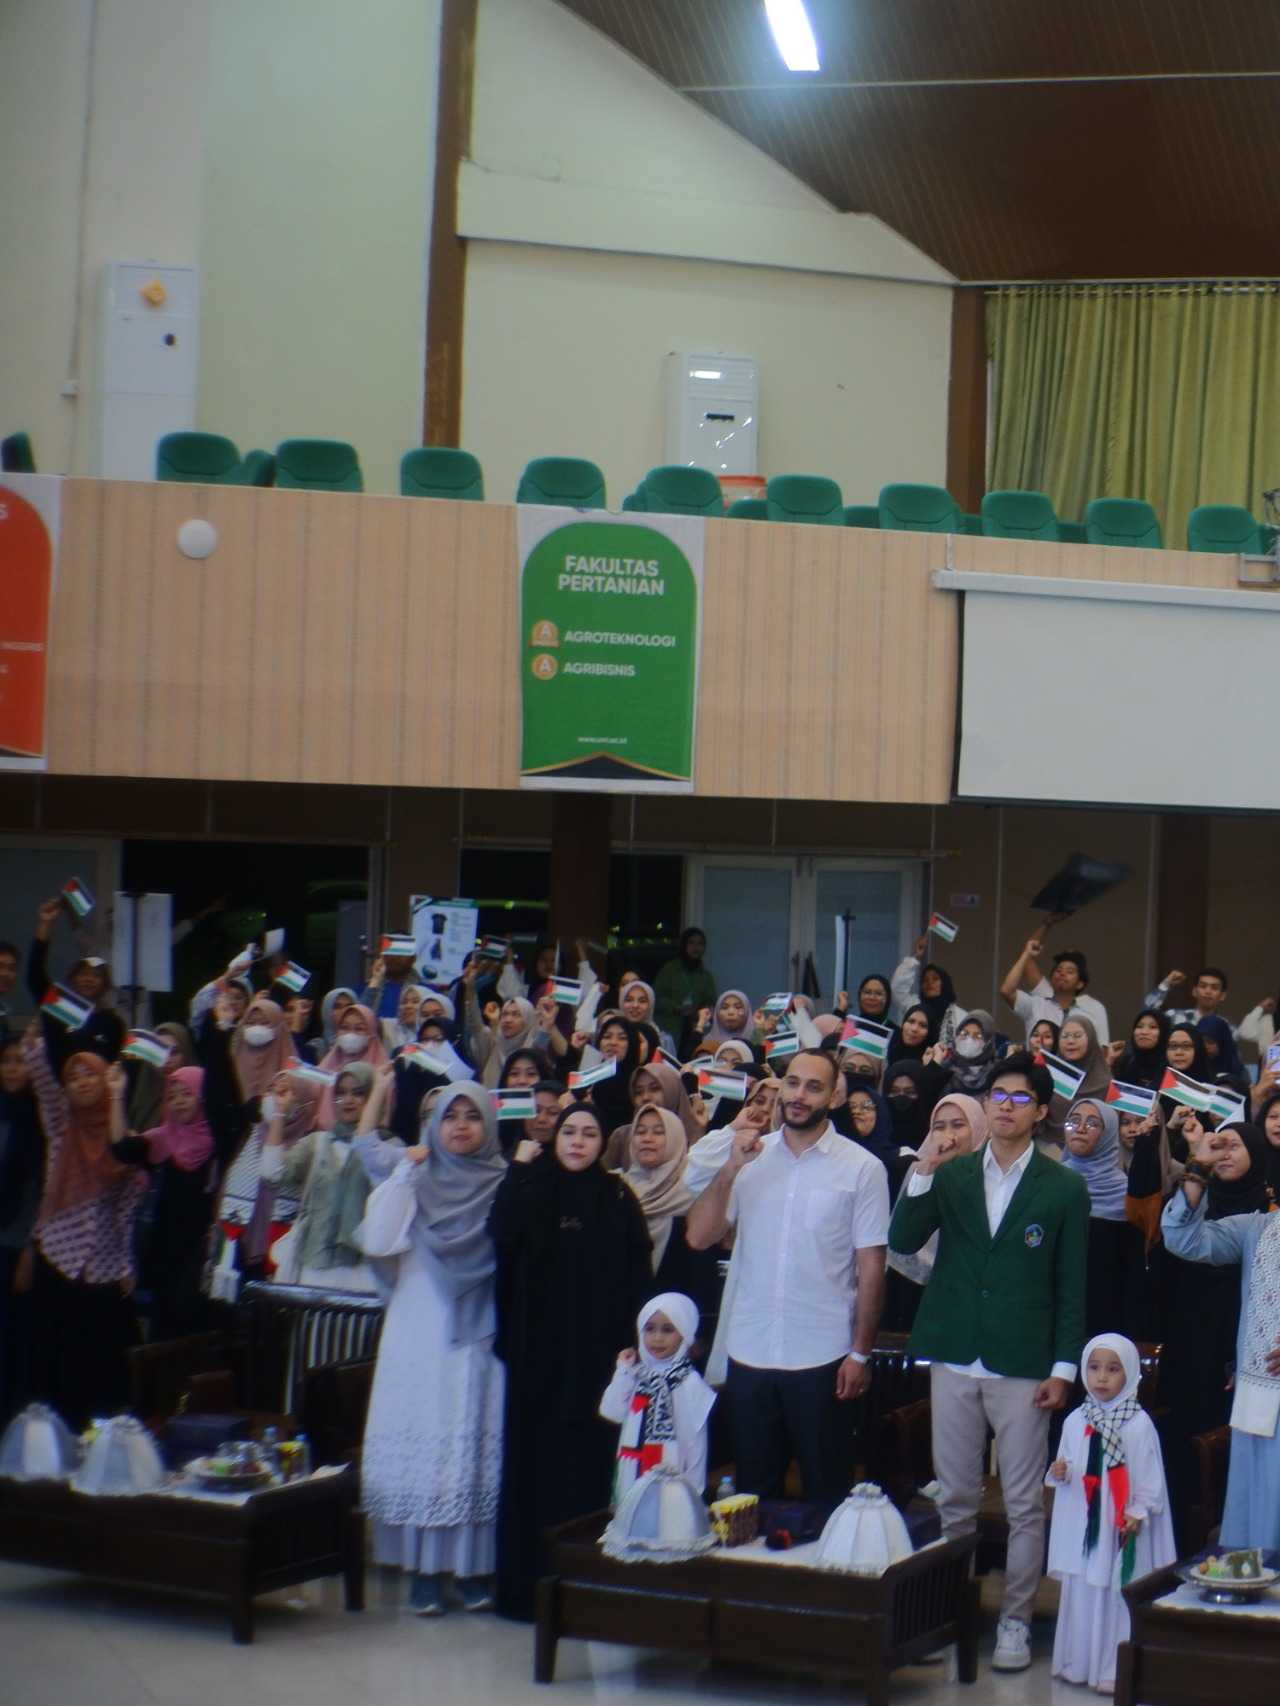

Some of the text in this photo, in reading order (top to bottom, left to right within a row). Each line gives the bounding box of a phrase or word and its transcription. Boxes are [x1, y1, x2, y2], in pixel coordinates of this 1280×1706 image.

[565, 555, 659, 577] FAKULTAS
[558, 573, 665, 596] PERTANIAN
[564, 630, 676, 648] AGROTEKNOLOGI
[563, 662, 636, 677] AGRIBISNIS
